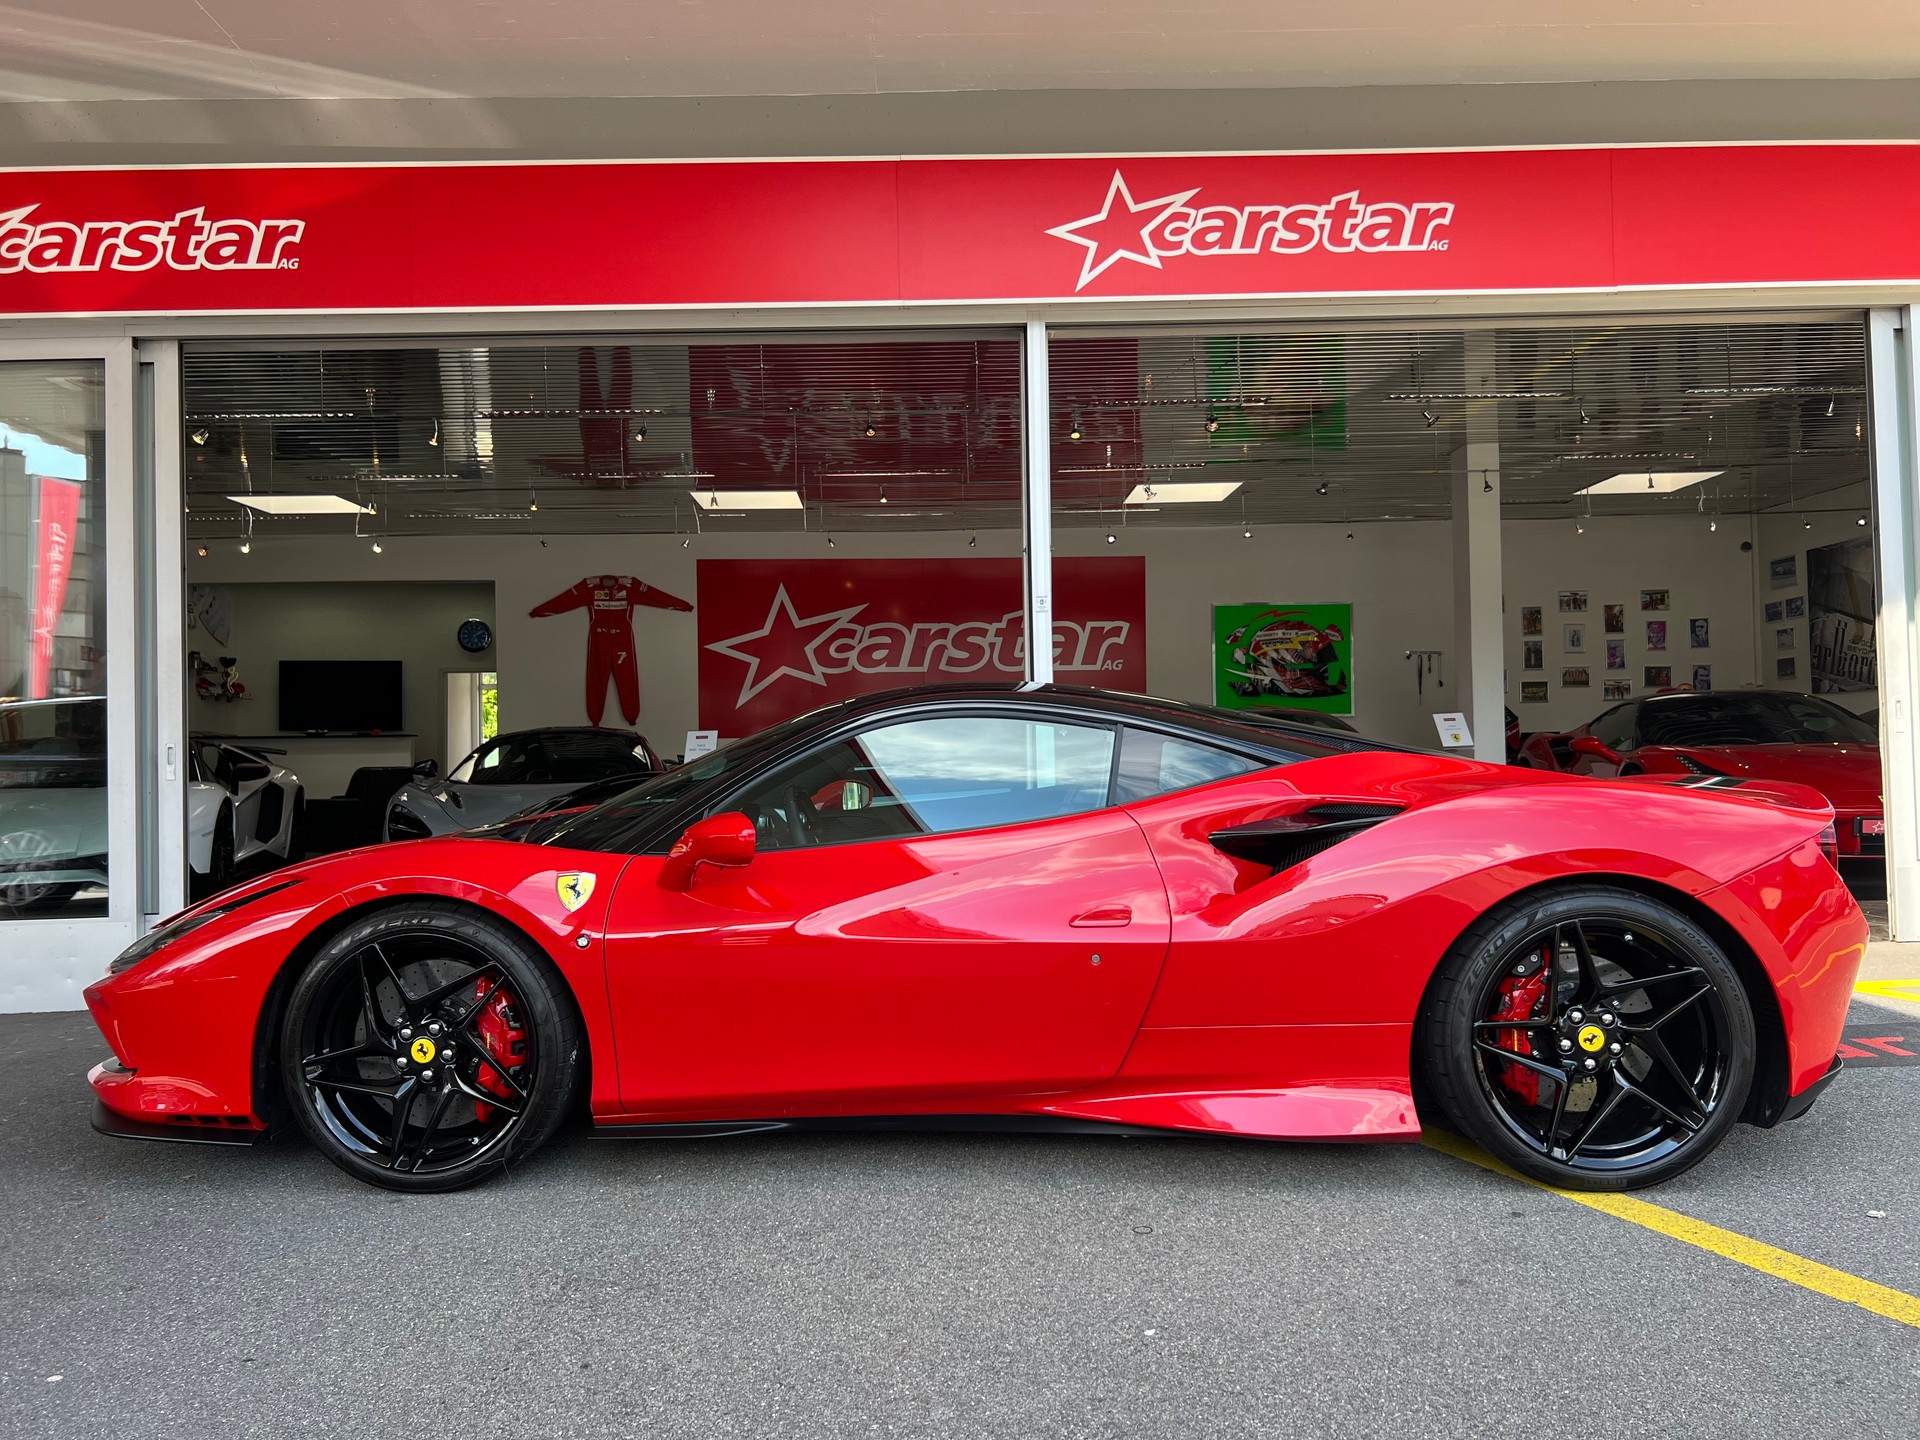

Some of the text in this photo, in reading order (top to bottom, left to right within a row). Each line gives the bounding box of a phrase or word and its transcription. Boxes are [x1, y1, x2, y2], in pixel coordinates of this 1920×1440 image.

[1150, 190, 1455, 256] carstar AG
[277, 258, 300, 270] AG
[617, 651, 627, 664] 7
[812, 611, 1130, 672] carstar AG
[1464, 933, 1507, 996] ZERO
[1679, 927, 1720, 964] 305/30
